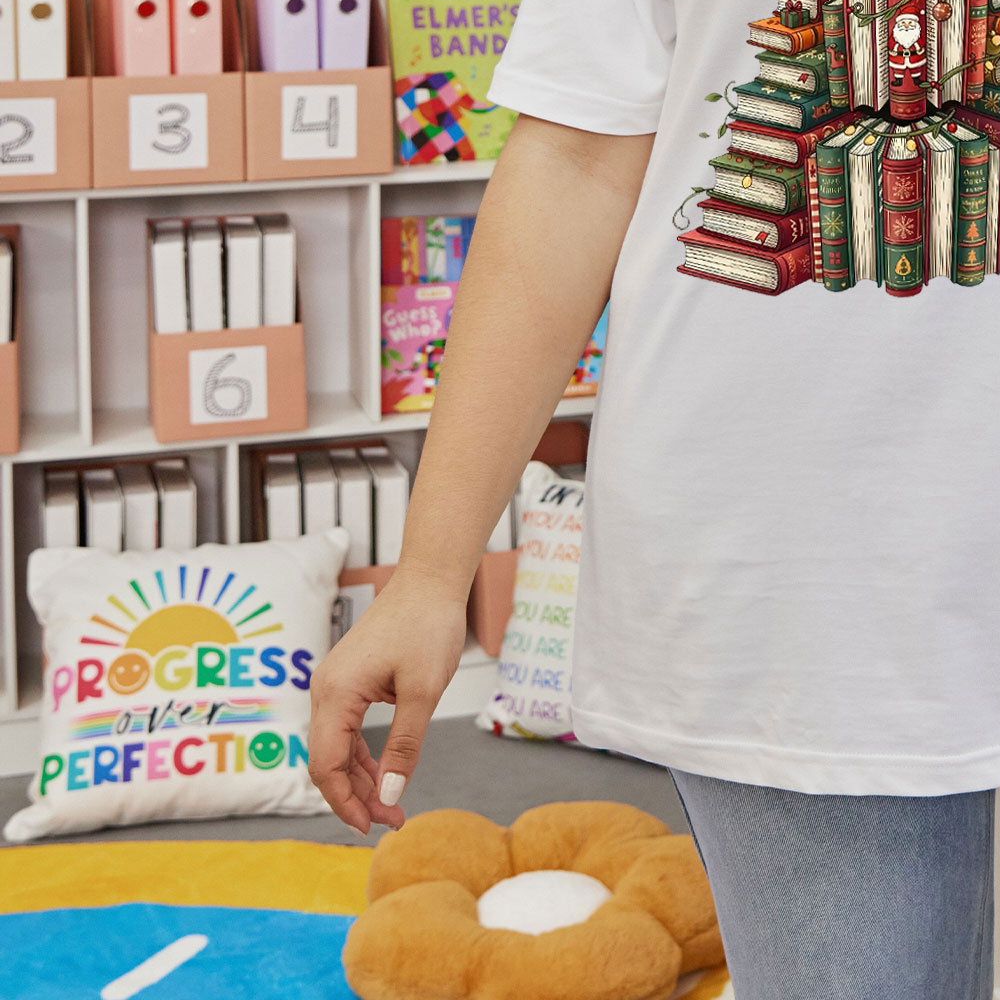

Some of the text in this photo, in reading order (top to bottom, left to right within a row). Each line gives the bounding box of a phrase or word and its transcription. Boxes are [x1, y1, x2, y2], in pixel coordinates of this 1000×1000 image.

[430, 34, 508, 58] BAND
[0, 113, 35, 163] 2
[152, 103, 191, 154] 3
[292, 96, 340, 149] 4
[383, 306, 438, 327] Guess
[388, 319, 442, 342] Who?
[203, 352, 252, 418] 6
[52, 646, 314, 713] PROGRESS
[530, 667, 565, 692] ARE
[116, 700, 240, 735] over
[39, 731, 310, 797] PERFECTION
